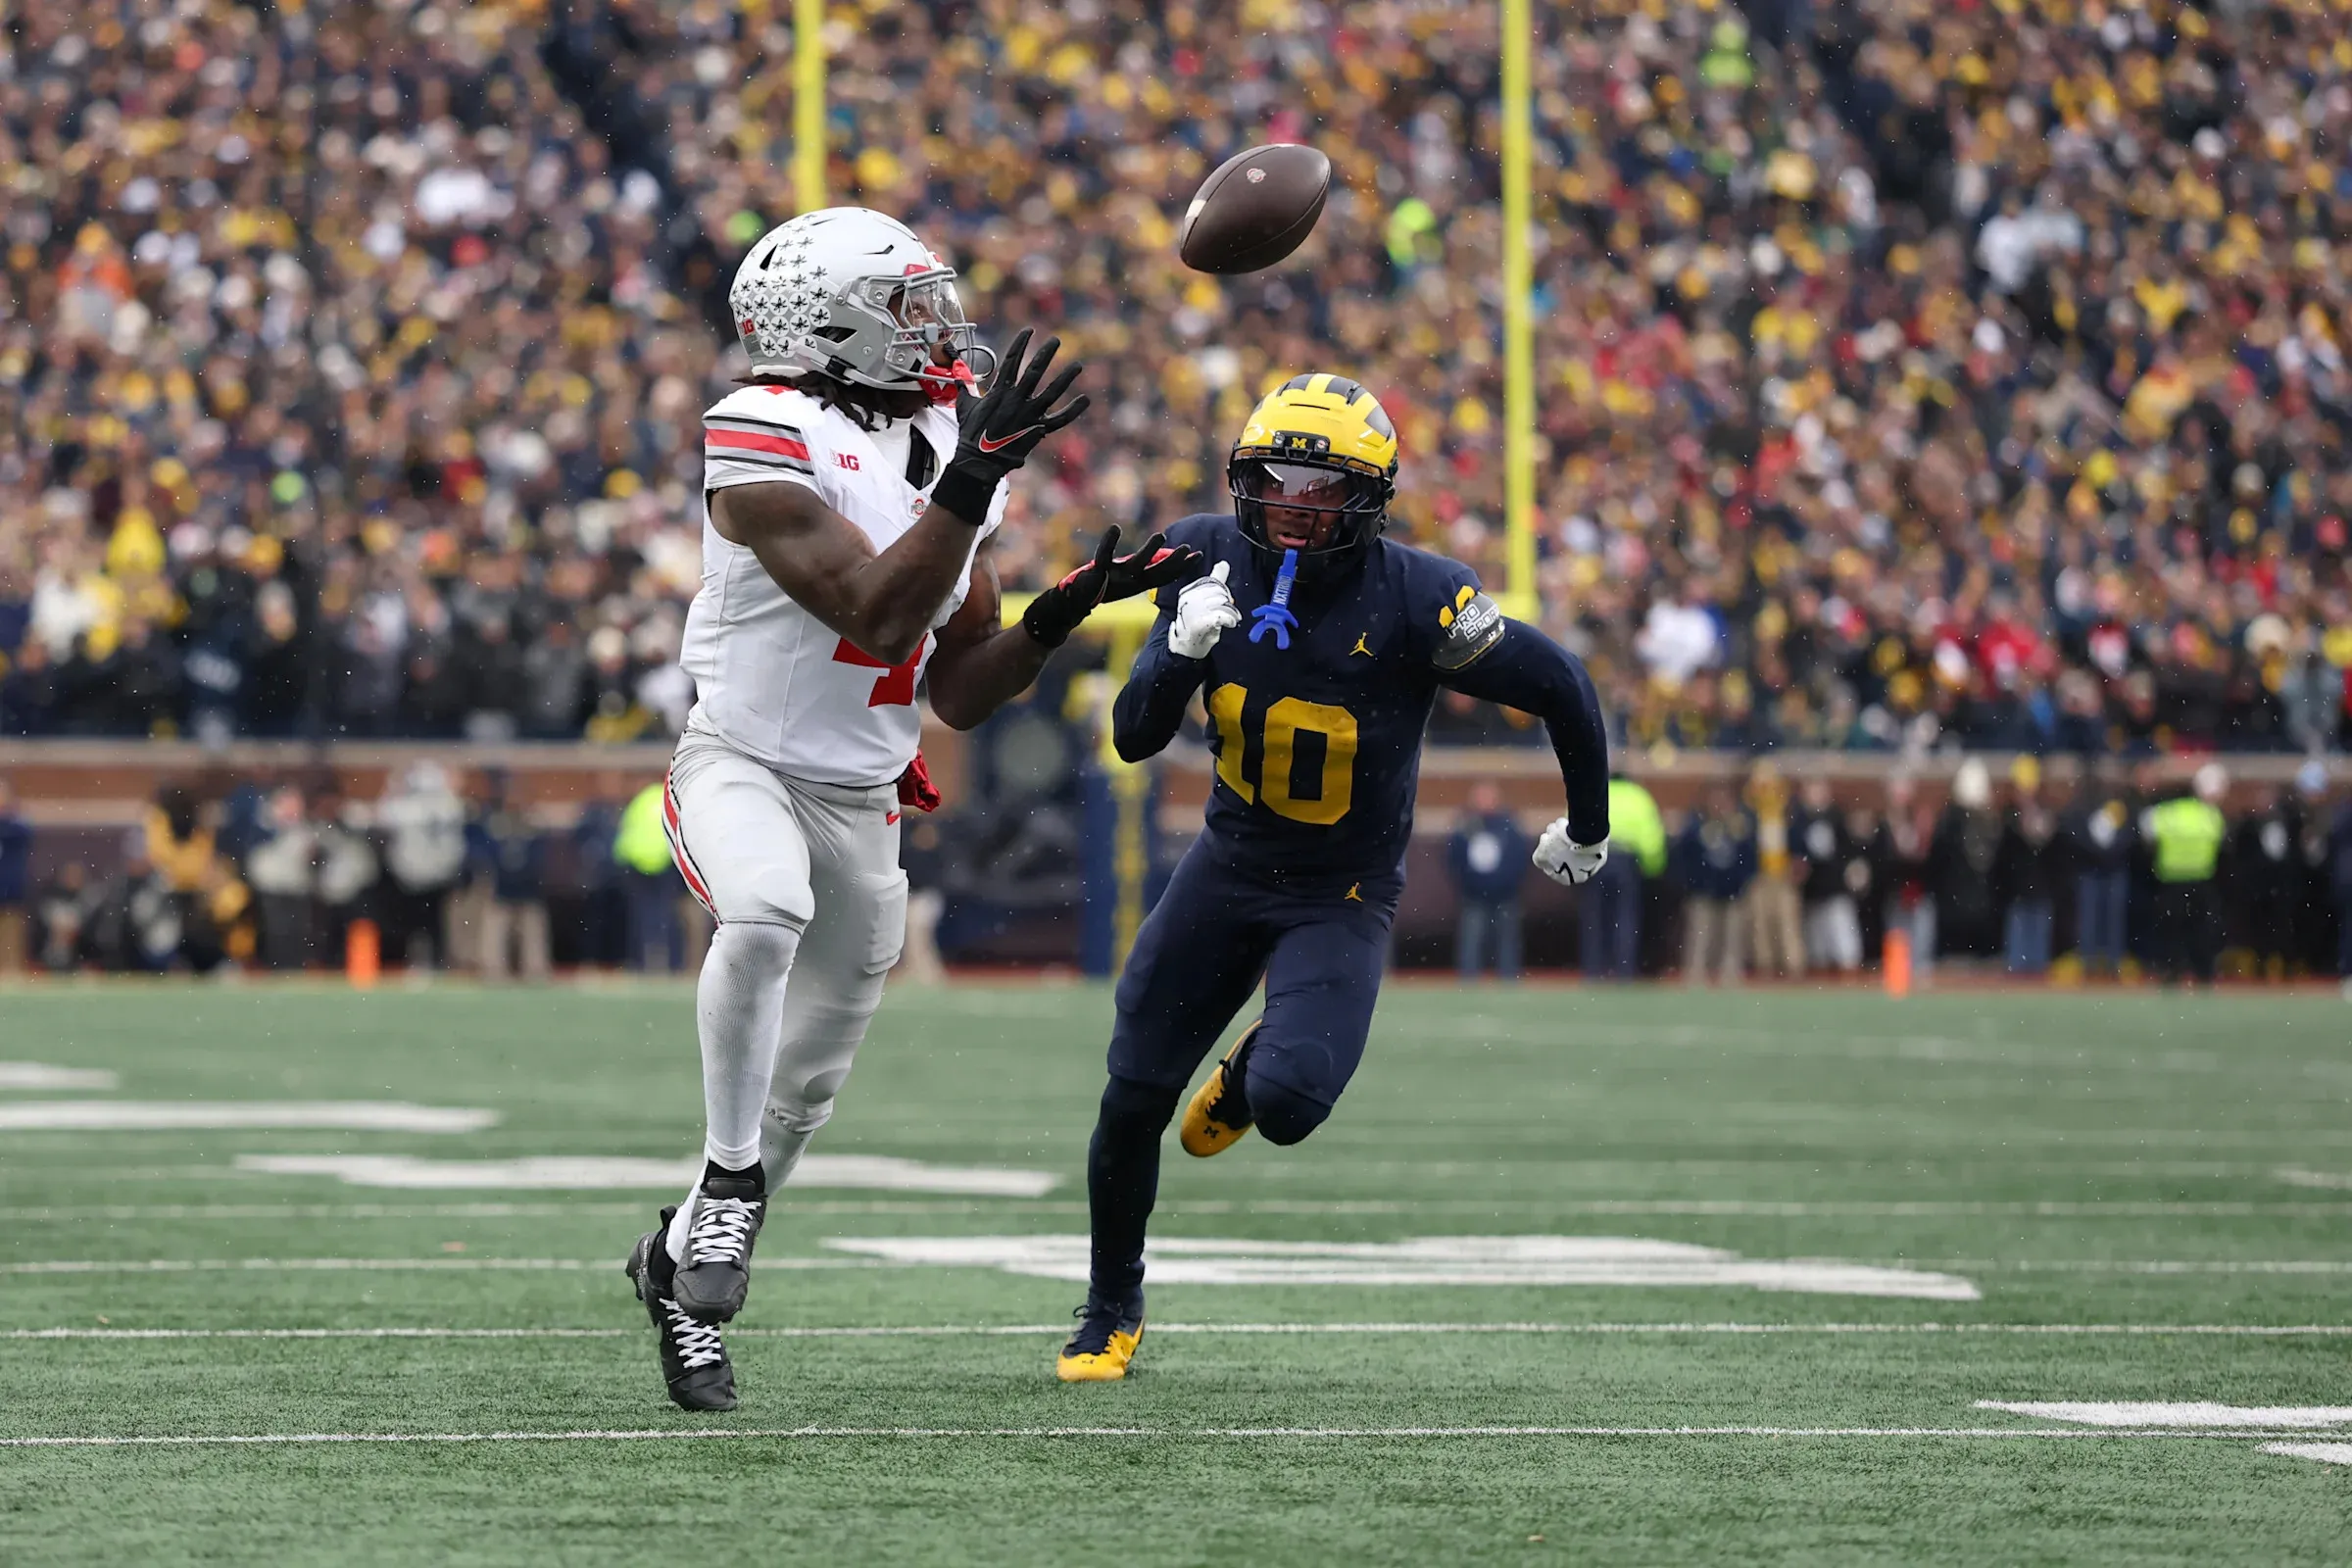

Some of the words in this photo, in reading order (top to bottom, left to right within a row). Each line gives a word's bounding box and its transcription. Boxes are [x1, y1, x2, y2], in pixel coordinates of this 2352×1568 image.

[1292, 436, 1307, 449] M
[1446, 604, 1480, 639] PRO
[1209, 682, 1358, 826] 10
